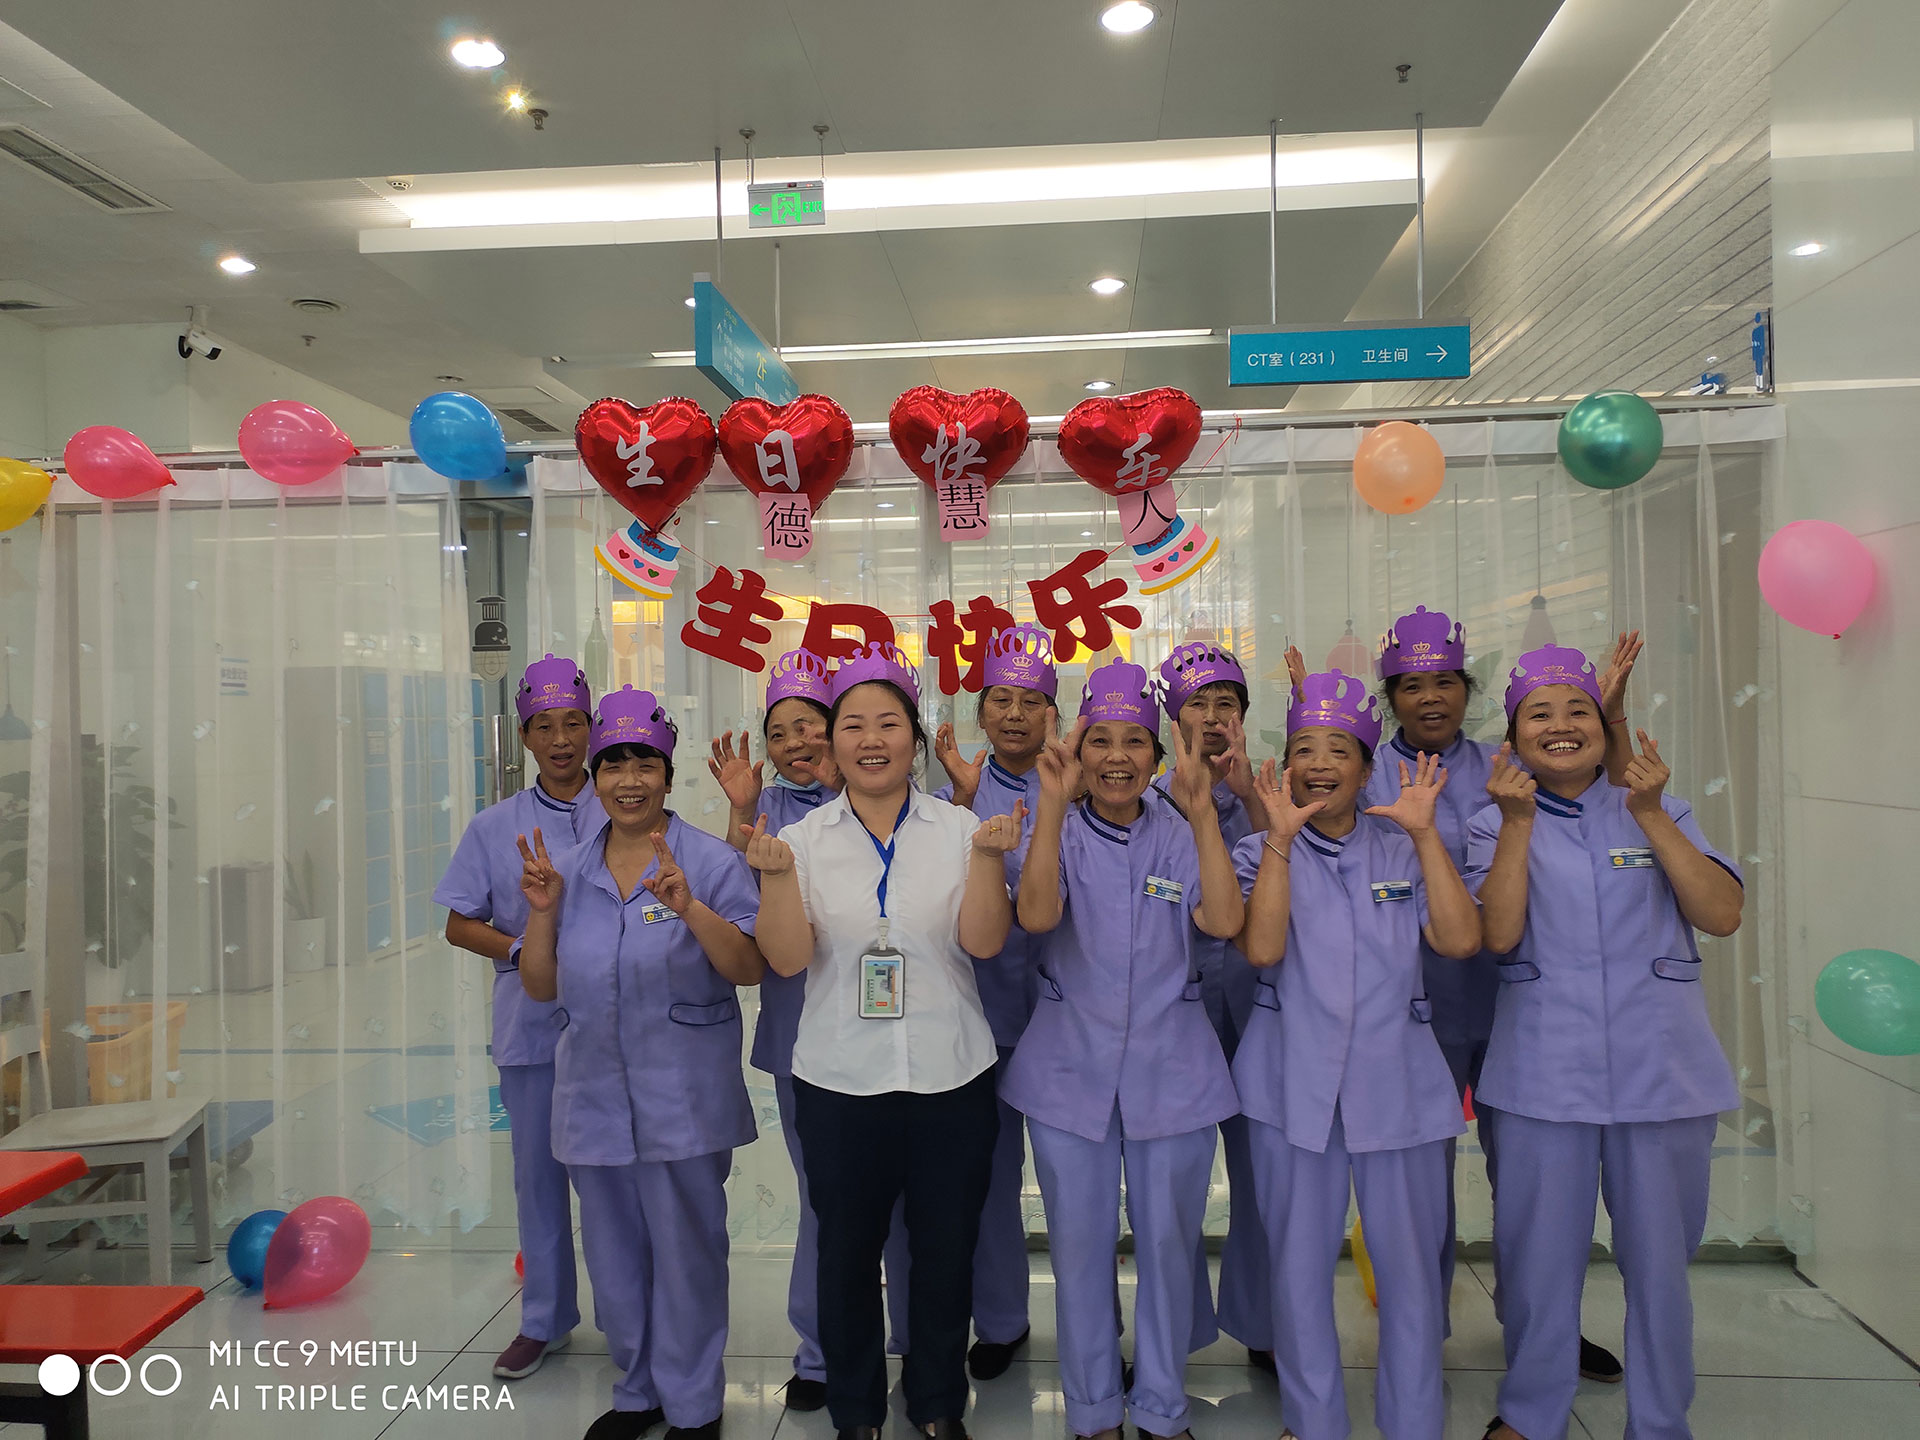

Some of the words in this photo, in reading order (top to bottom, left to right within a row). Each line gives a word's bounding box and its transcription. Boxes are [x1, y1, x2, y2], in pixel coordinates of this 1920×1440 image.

[802, 200, 823, 213] EXIT
[1362, 348, 1408, 363] 卫生间
